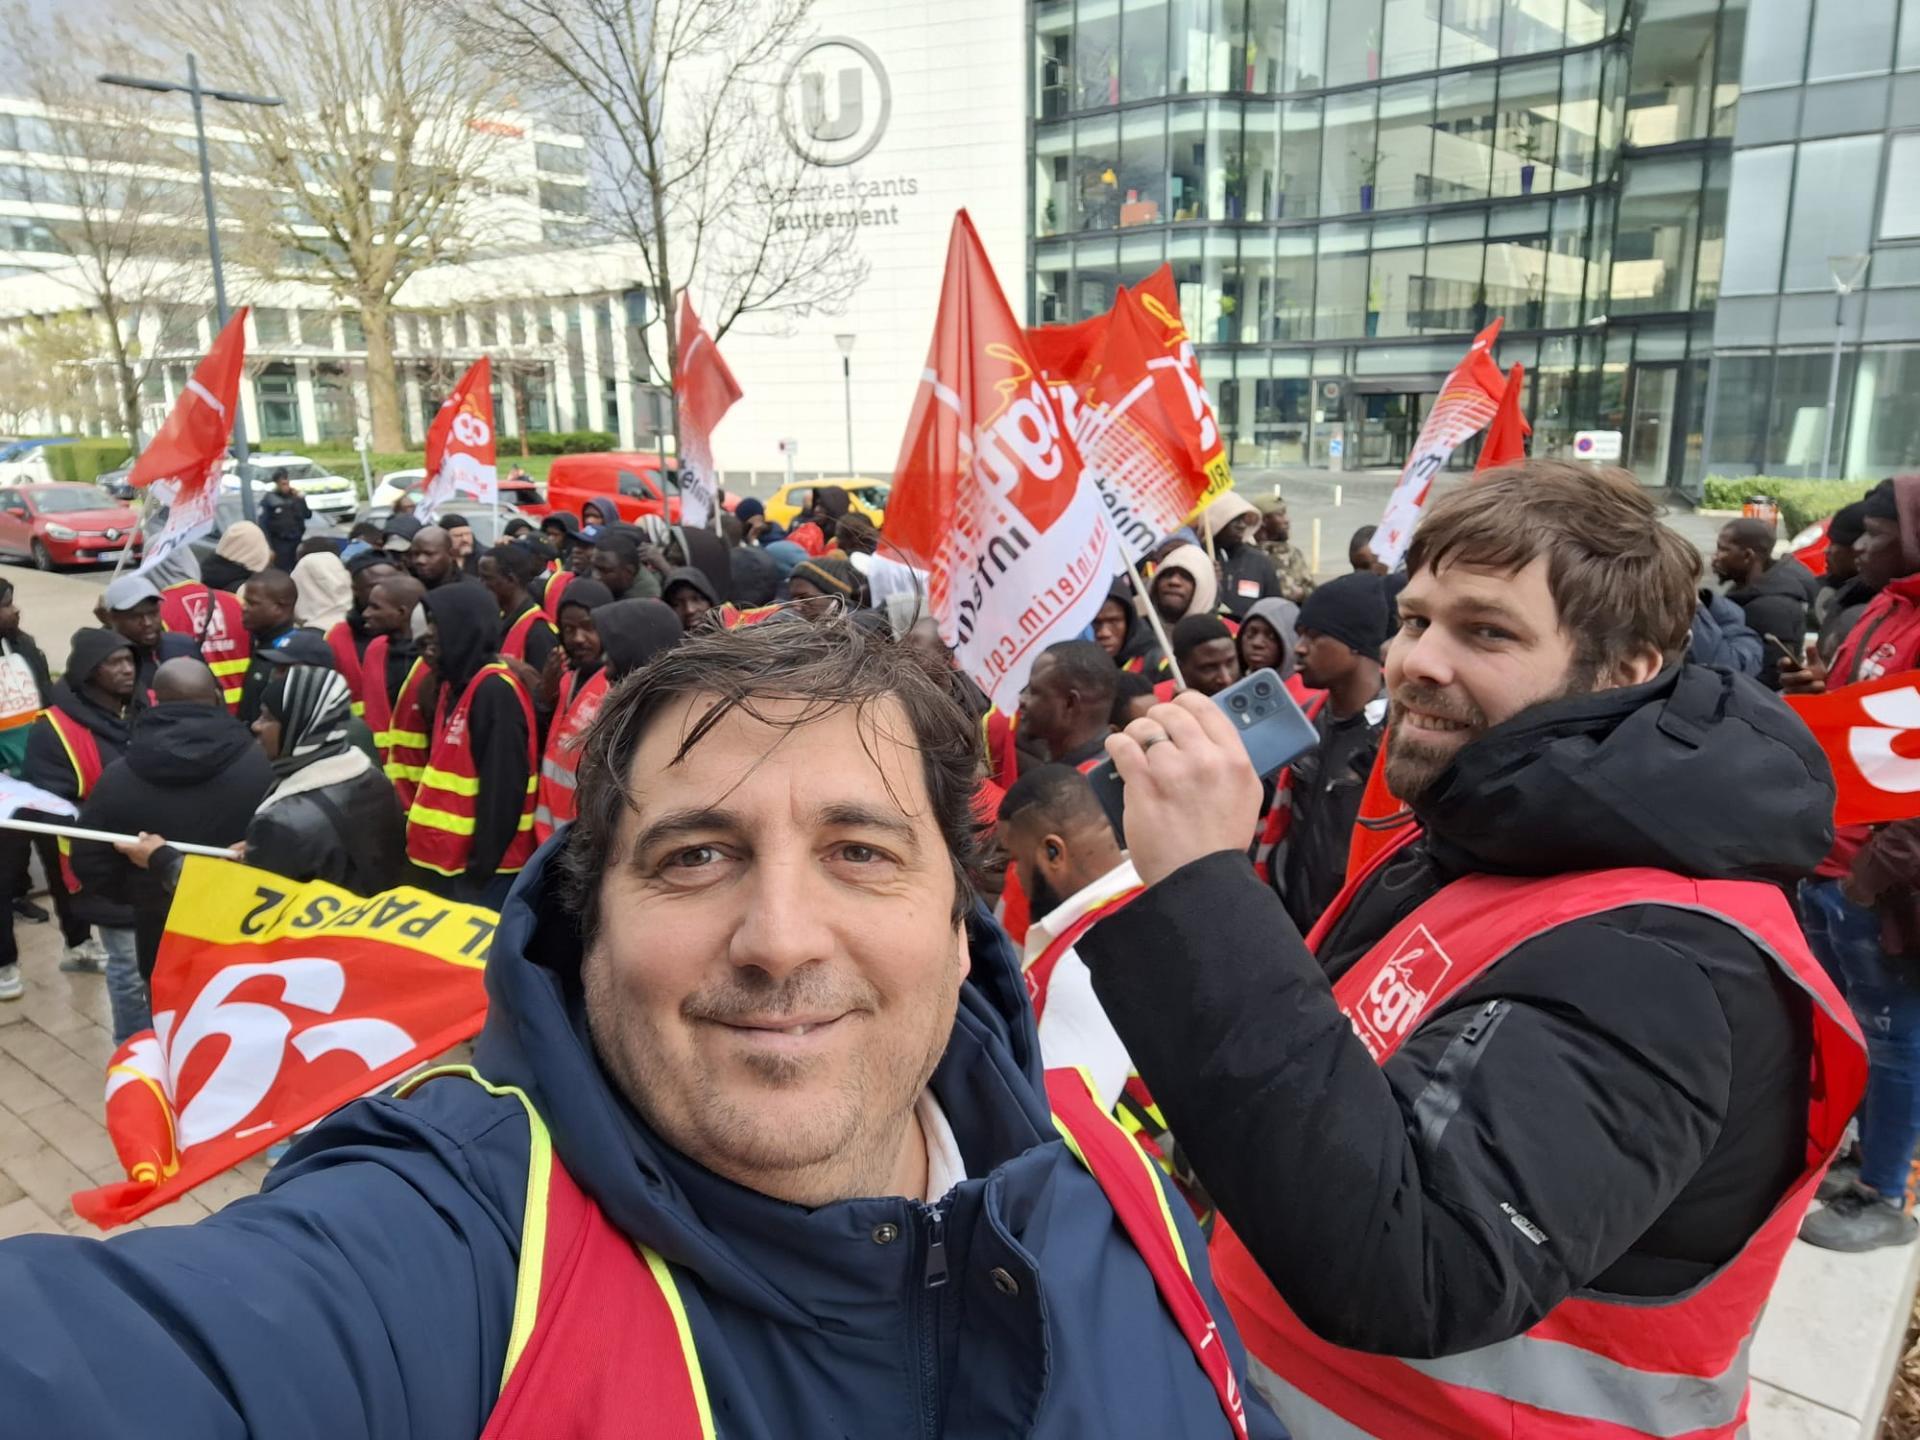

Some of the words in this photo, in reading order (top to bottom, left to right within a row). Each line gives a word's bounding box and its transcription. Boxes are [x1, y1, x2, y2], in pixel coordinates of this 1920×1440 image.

[800, 68, 863, 142] U
[775, 204, 899, 232] autrement
[1370, 966, 1427, 1036] cgt
